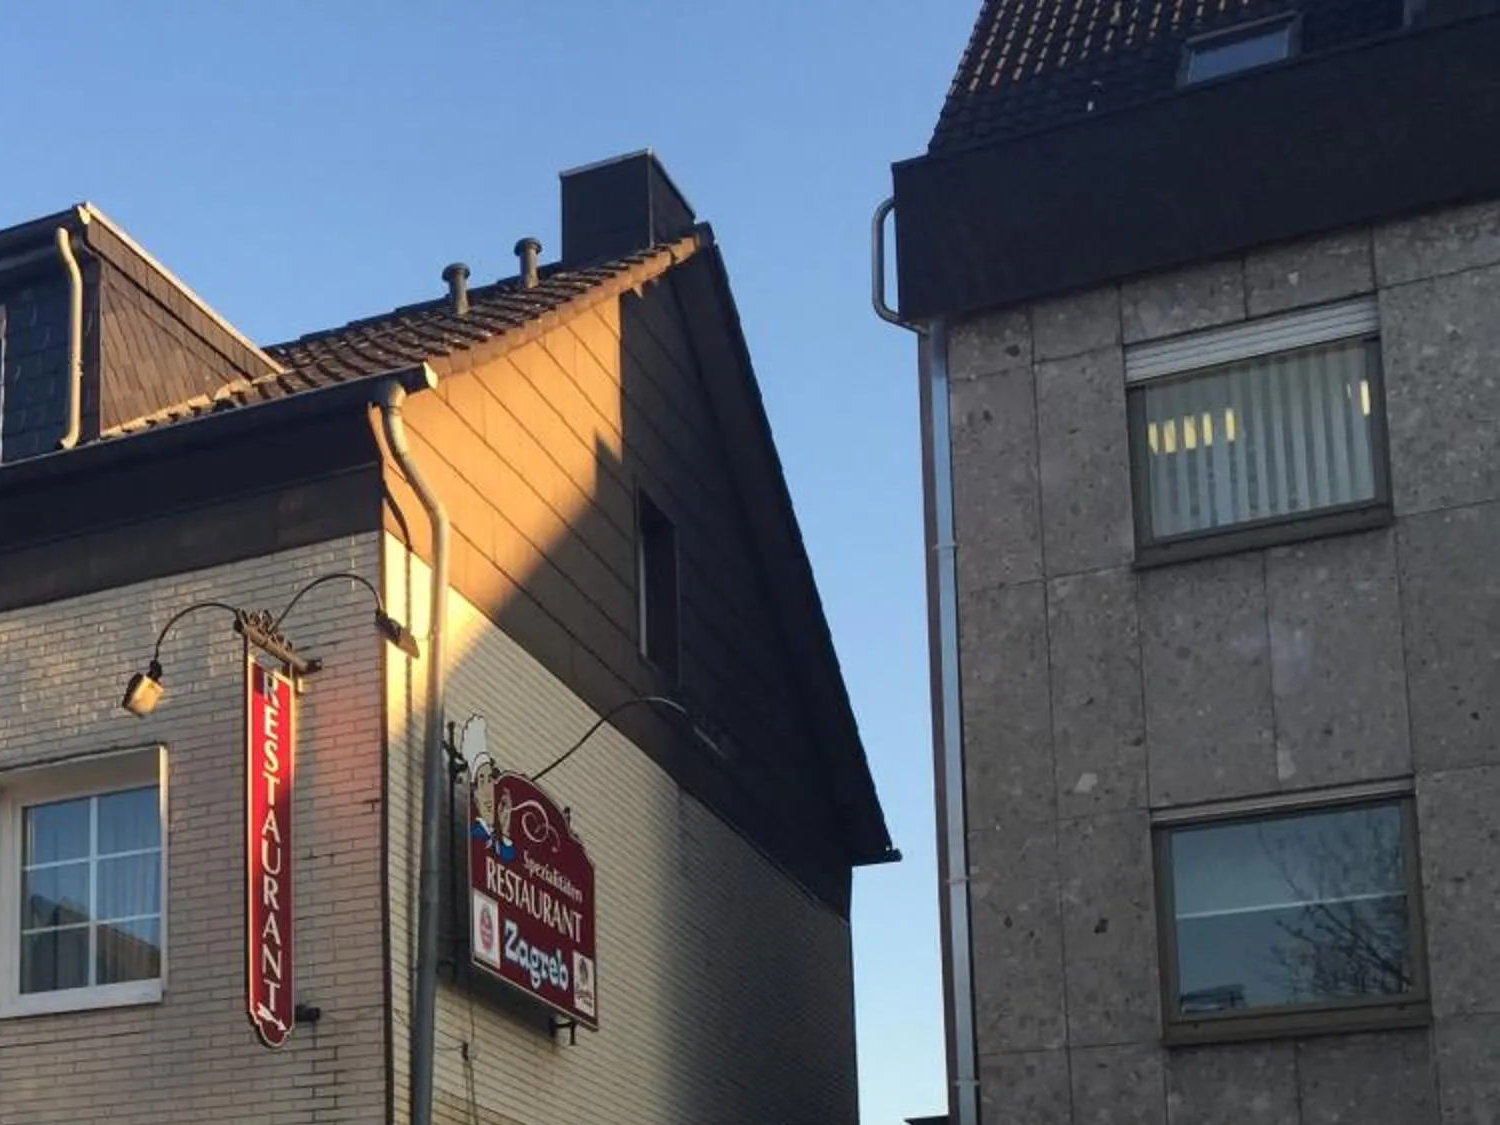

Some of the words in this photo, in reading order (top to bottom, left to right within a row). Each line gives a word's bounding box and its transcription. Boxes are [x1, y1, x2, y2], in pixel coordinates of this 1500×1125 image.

[261, 669, 281, 1013] RESTAURANT
[486, 856, 583, 943] RESTAURANT
[504, 918, 569, 991] Zagreb
